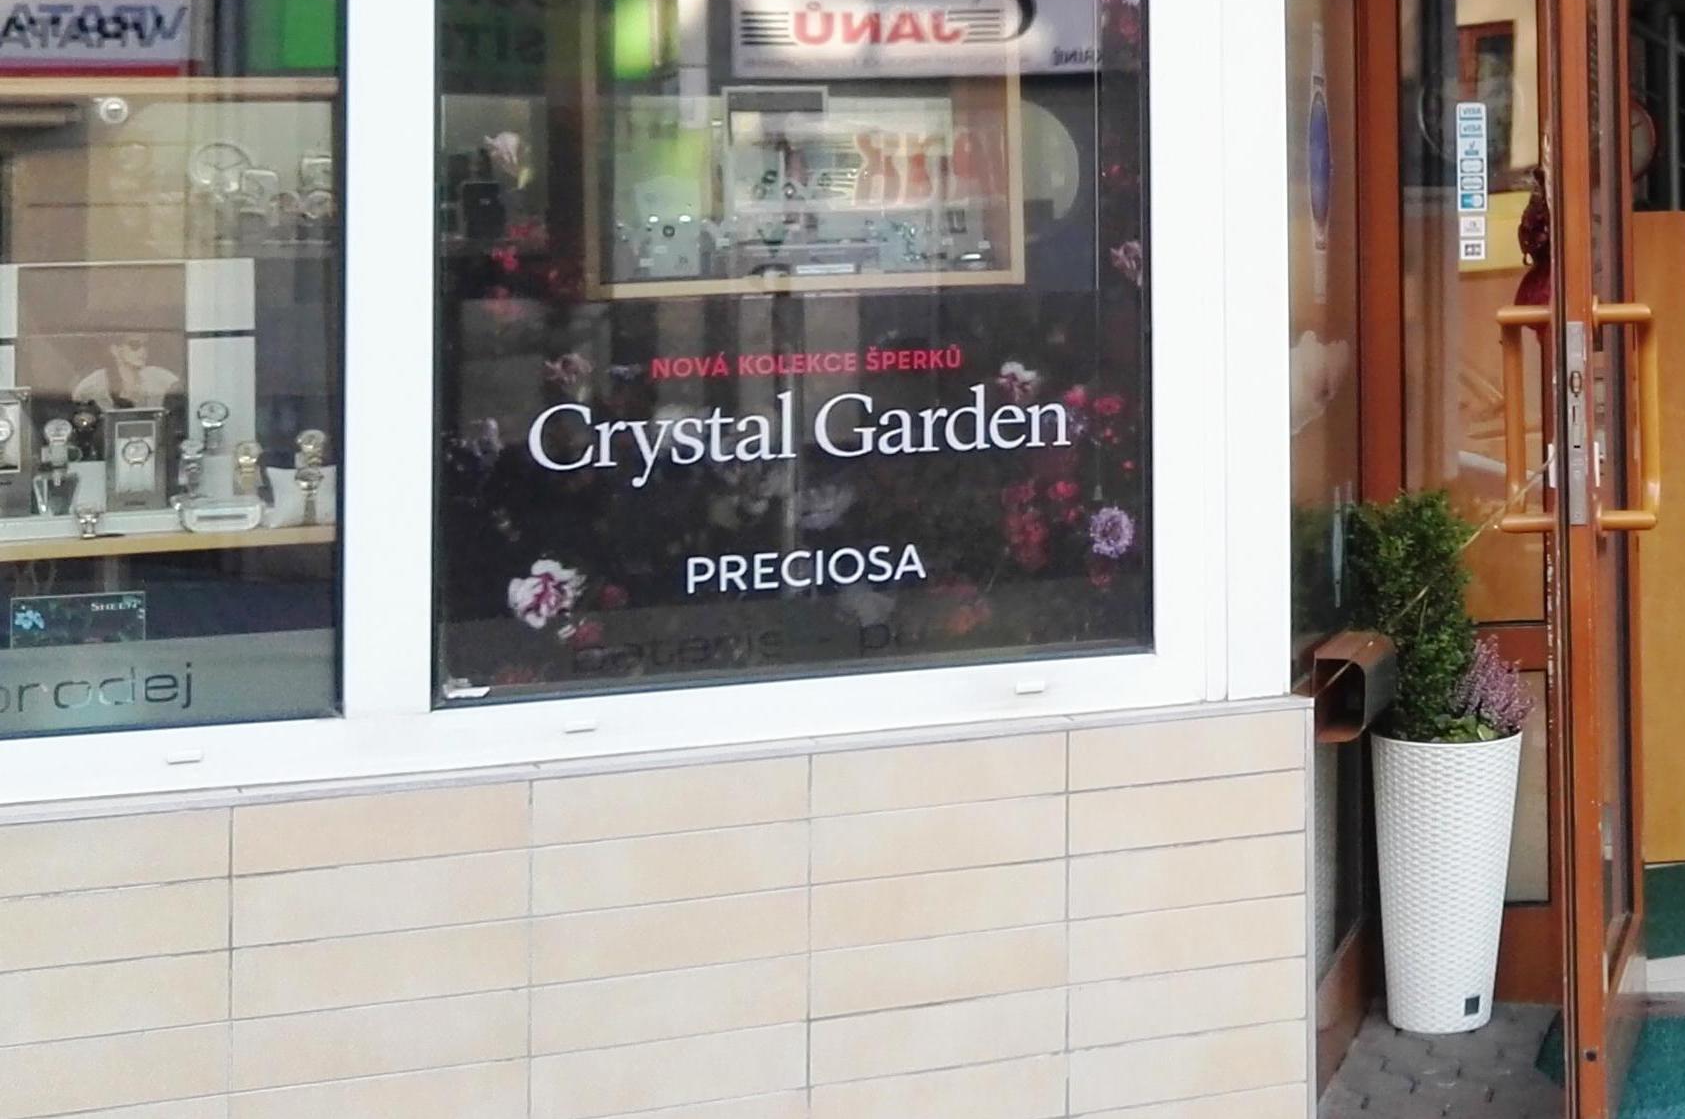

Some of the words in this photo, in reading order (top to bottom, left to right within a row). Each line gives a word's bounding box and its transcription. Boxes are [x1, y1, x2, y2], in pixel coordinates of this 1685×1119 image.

[651, 349, 729, 379] NOVÁ
[738, 351, 858, 377] KOLEKCE
[866, 342, 963, 372] ŠPERKŮ
[528, 389, 797, 488] Crystal
[814, 384, 1073, 458] Garden
[686, 543, 927, 594] PRECIOSA
